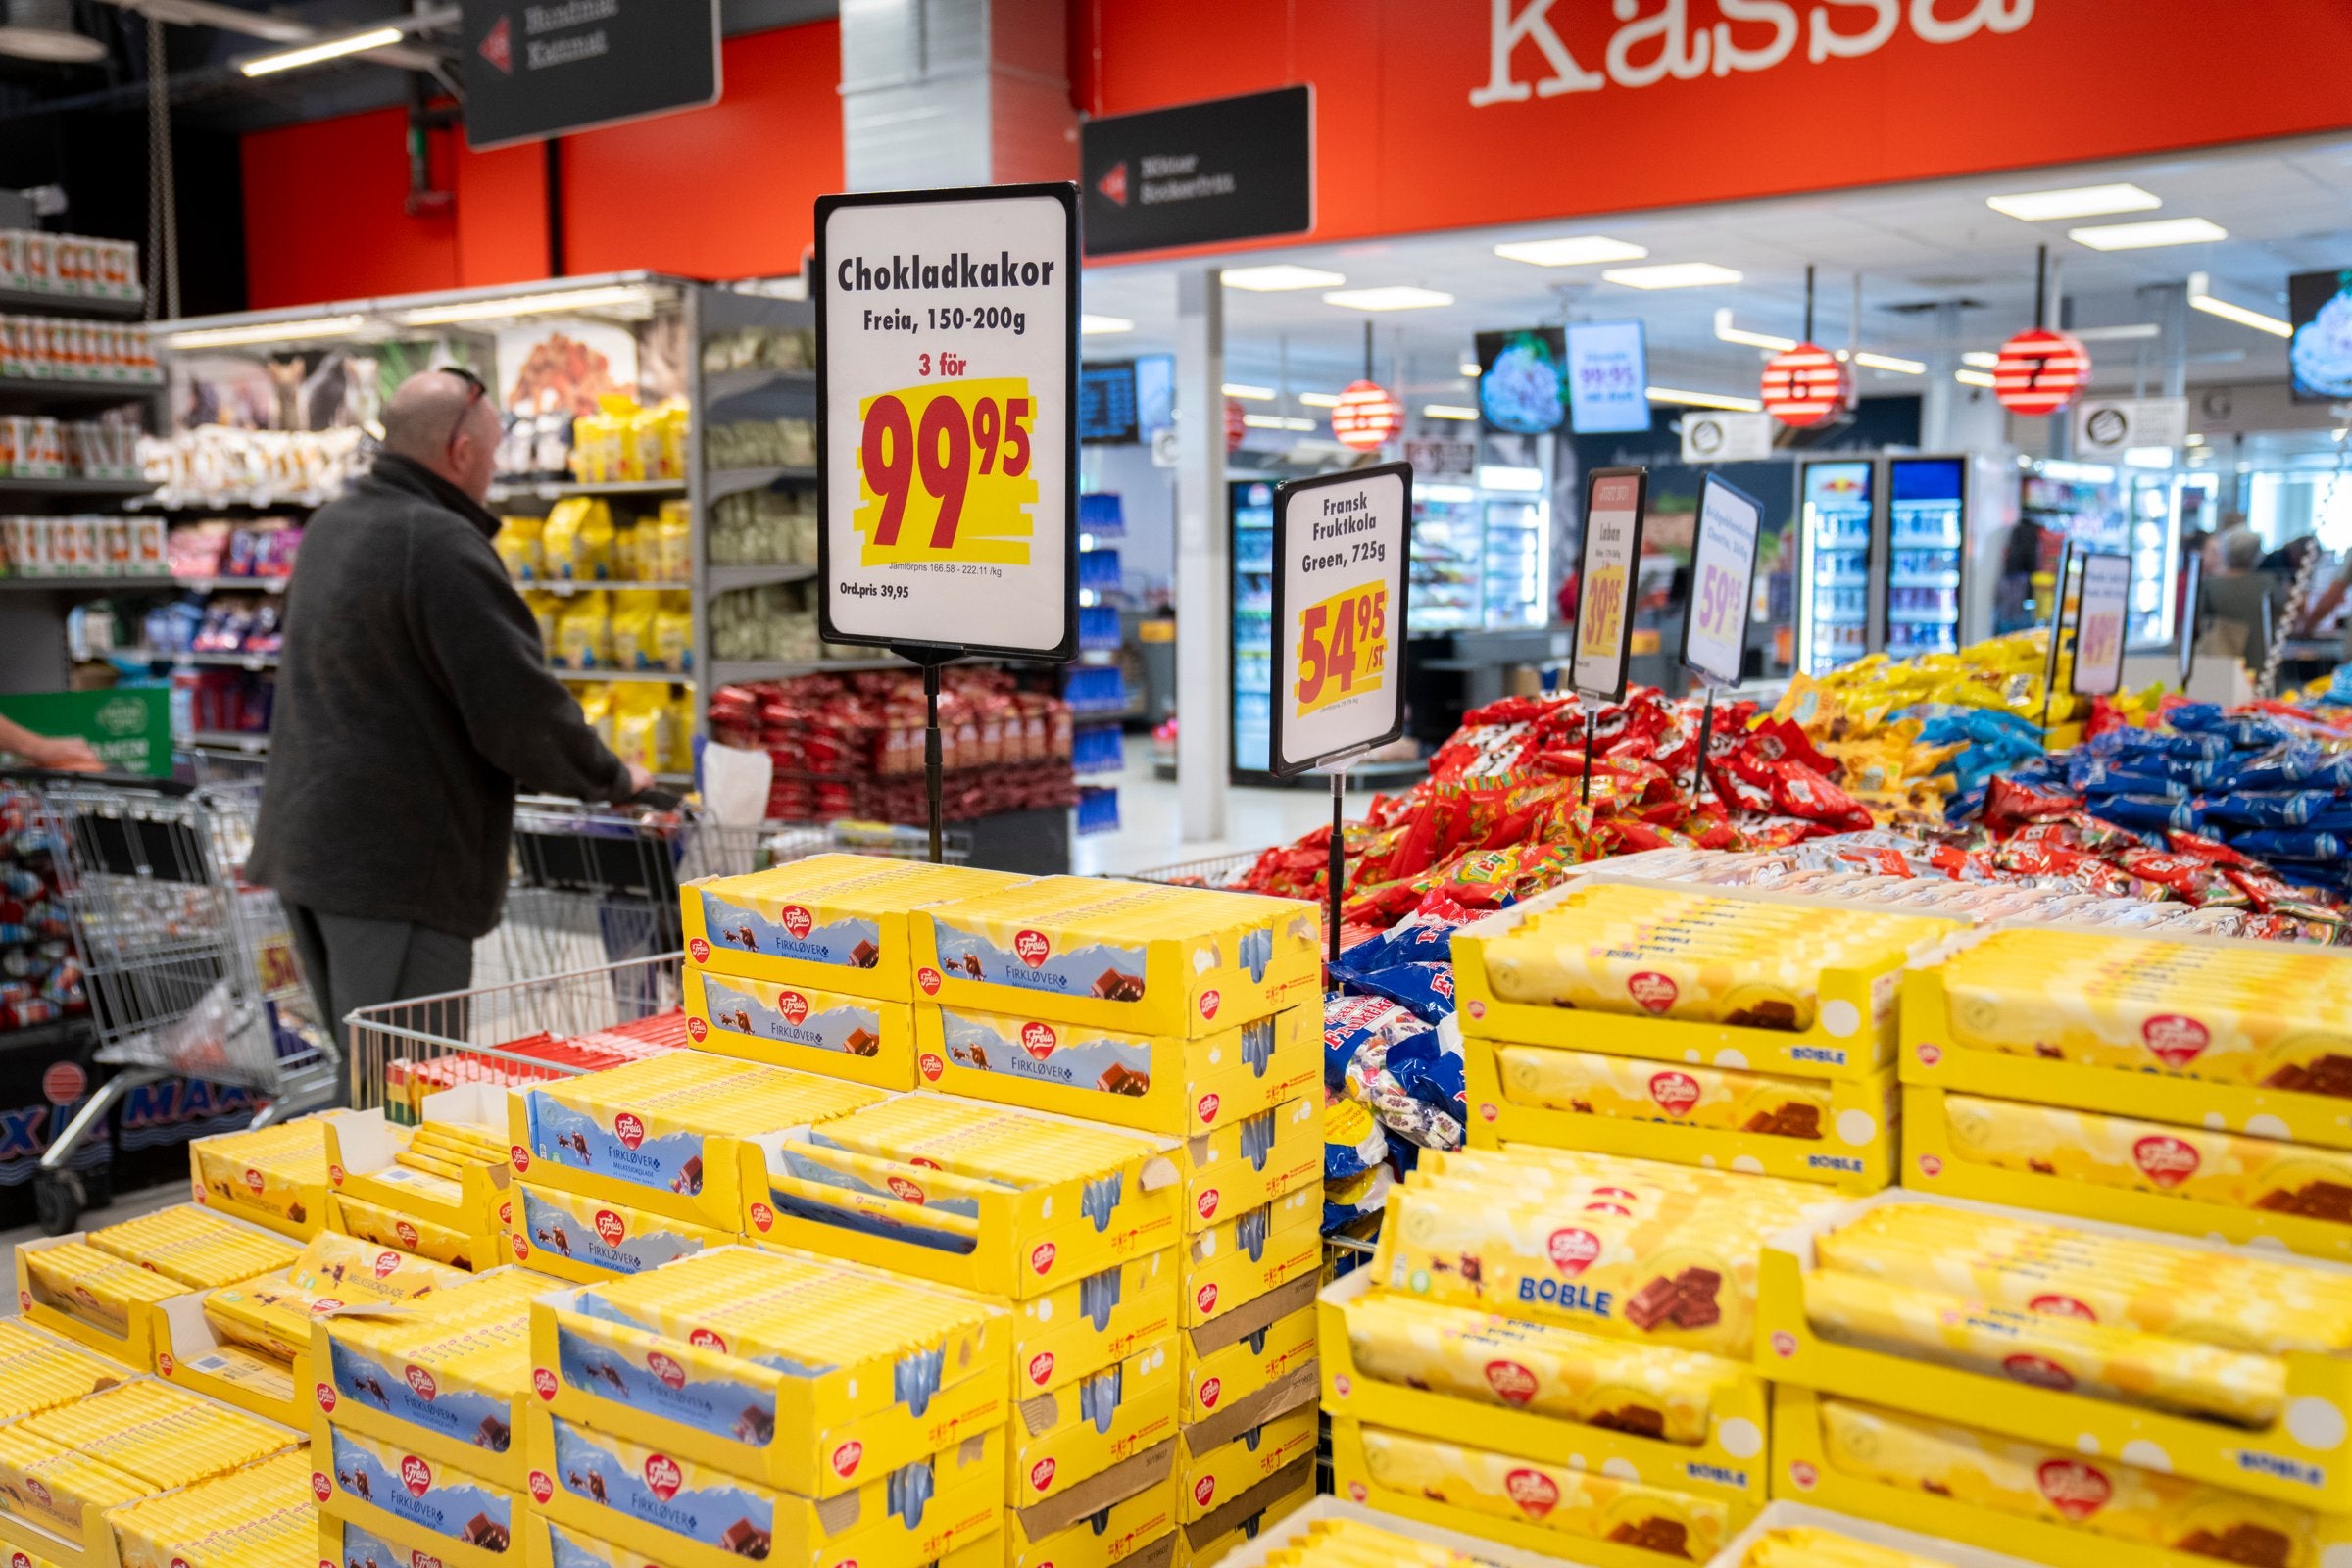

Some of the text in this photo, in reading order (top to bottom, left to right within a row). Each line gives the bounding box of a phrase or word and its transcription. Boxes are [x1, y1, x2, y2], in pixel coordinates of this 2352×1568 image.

[838, 251, 1054, 291] Chokladkakor
[863, 306, 1026, 335] Freia, 150-200g
[918, 352, 967, 376] 3 för
[2021, 354, 2046, 388] 7
[1789, 369, 1809, 400] 6
[1324, 491, 1367, 516] Fransk
[1313, 513, 1376, 541] Fruktkola
[1599, 522, 1620, 542] Laban
[1302, 541, 1385, 572] Green, 725g
[889, 562, 927, 572] Jämförpris
[930, 564, 956, 574] 166.58
[962, 565, 988, 575] 222.11
[990, 566, 1002, 577] /kg
[840, 581, 909, 599] Ord.pris 39,95
[785, 908, 809, 928] Freia
[691, 941, 709, 956] Freia
[776, 938, 823, 956] FIRKLØVER
[1019, 934, 1047, 956] Freia
[920, 970, 940, 987] Freia
[1006, 965, 1060, 987] FIRKLØVER
[782, 995, 807, 1014] Freia
[690, 1020, 707, 1035] Freia
[771, 1023, 817, 1043] FIRKLØVER
[1025, 1026, 1054, 1049] Freia
[922, 1056, 943, 1073] Freia
[1792, 1047, 1846, 1065] BOBLE
[1011, 1057, 1065, 1079] FIRKLØVER
[617, 1117, 643, 1138] Freia
[609, 1146, 654, 1168] FIRKLØVER
[1809, 1155, 1864, 1173] BOBLE
[599, 1214, 623, 1236] Freia
[753, 1206, 772, 1224] Freia
[589, 1243, 635, 1265] FIRKLØVER
[1518, 1277, 1613, 1317] BOBLE
[408, 1370, 434, 1391] Freia
[536, 1373, 557, 1393] Freia
[1200, 1380, 1220, 1402] Freia
[318, 1387, 335, 1405] Freia
[404, 1460, 430, 1485] Freia
[648, 1460, 680, 1487] Freia
[1686, 1462, 1748, 1488] BOBLE
[315, 1476, 331, 1494] Freia
[530, 1476, 552, 1494] Freia
[1196, 1478, 1214, 1499] Freia
[391, 1490, 438, 1521] FIRKLØVER
[632, 1493, 689, 1525] FIRKLØVER
